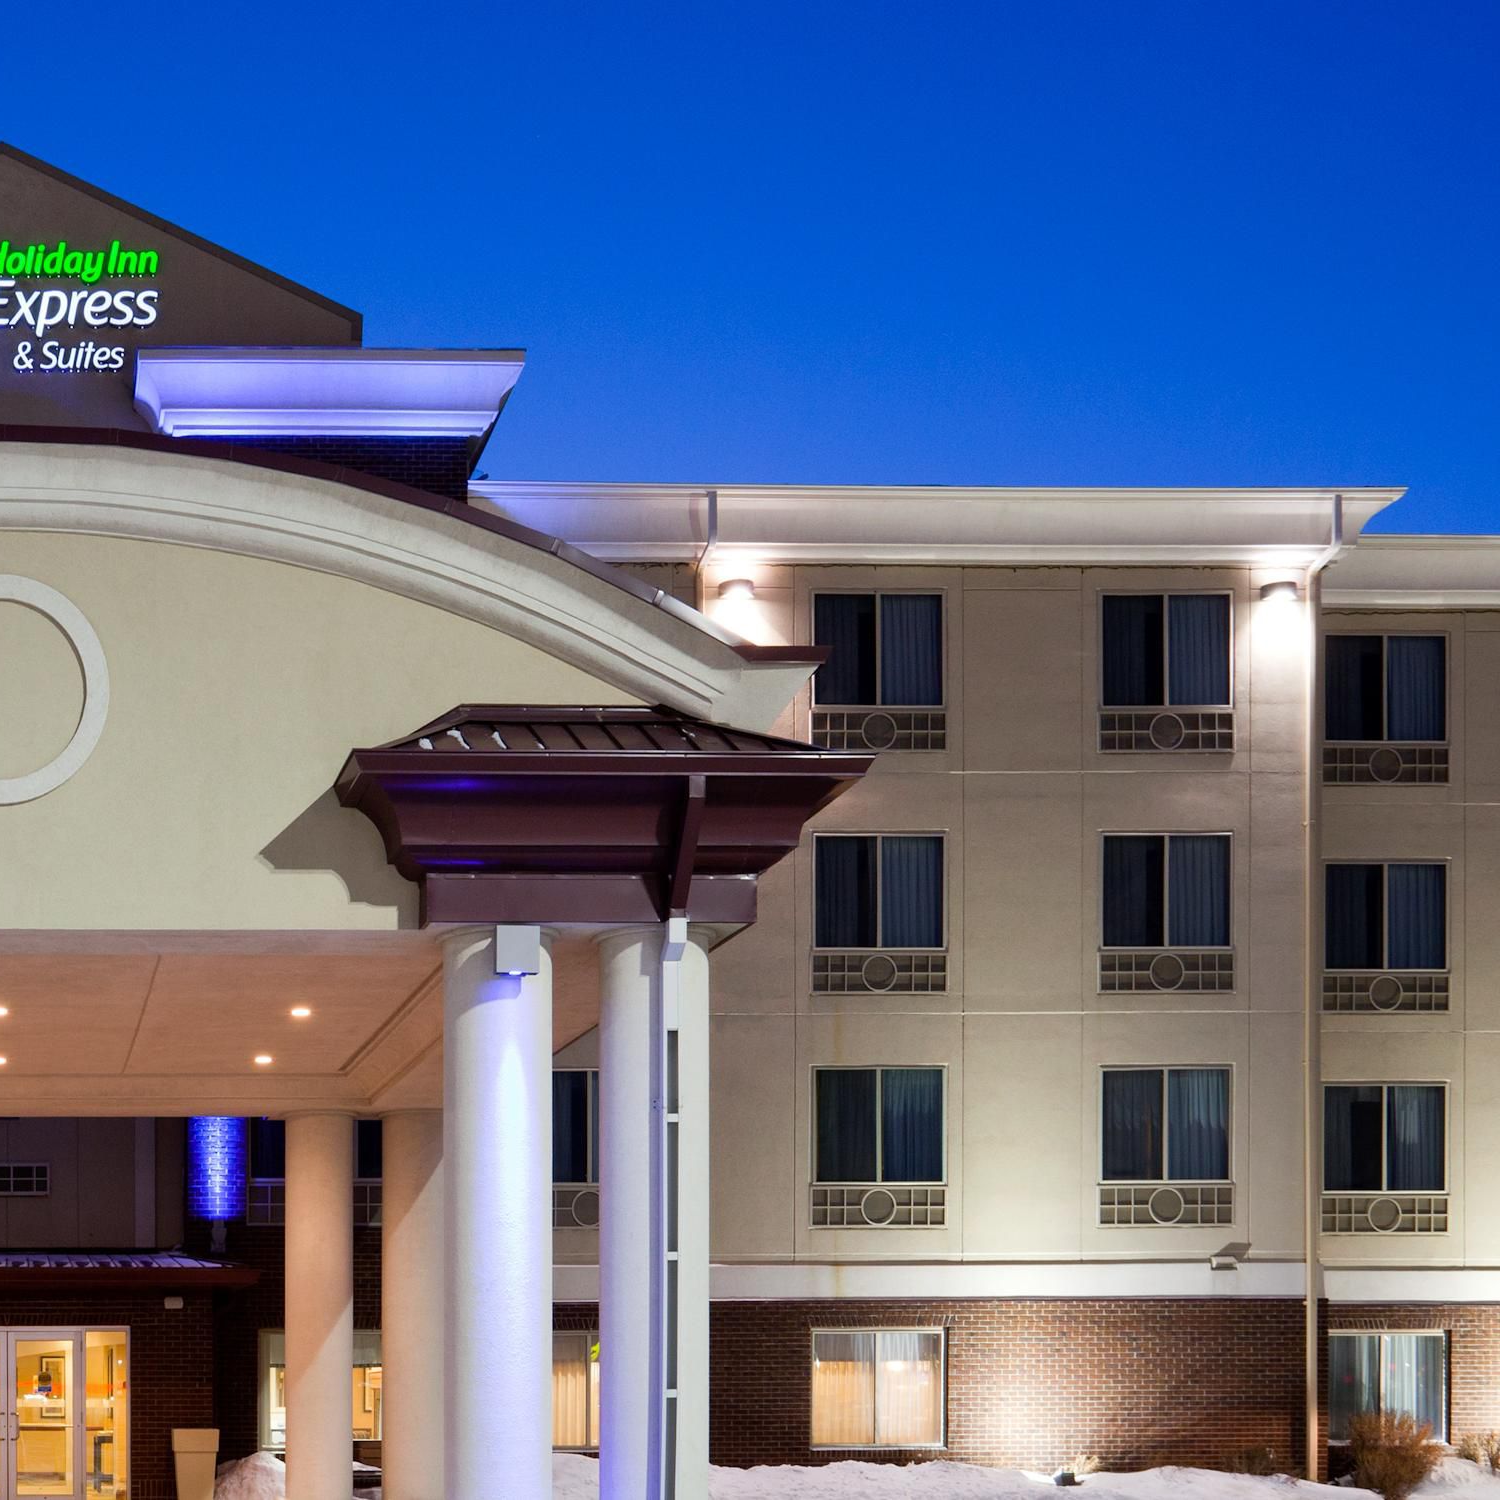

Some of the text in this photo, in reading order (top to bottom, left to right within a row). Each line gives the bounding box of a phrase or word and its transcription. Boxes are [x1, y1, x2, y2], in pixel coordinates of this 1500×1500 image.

[107, 240, 159, 274] Inn
[13, 341, 125, 370] & Suites
